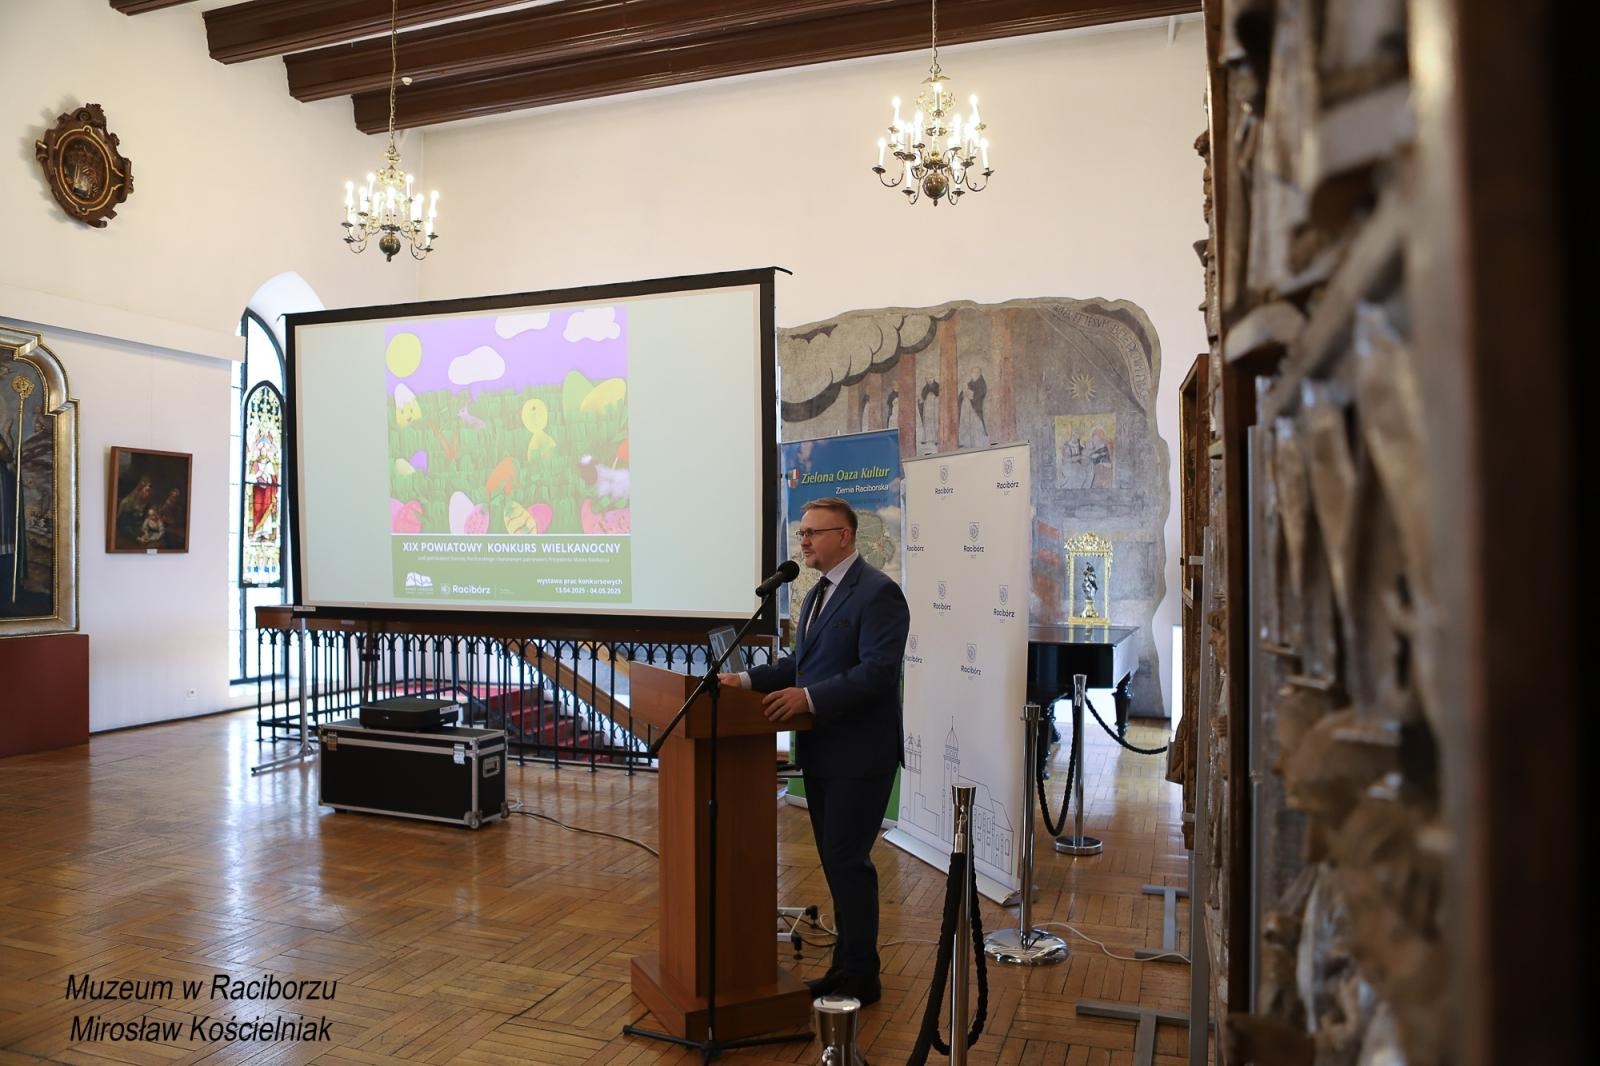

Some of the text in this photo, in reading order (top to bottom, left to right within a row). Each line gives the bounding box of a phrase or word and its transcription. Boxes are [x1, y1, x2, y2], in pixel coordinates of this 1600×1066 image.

[801, 465, 890, 485] Zielona Oaza Kultur
[855, 483, 889, 493] Raciborska
[996, 480, 1019, 489] Racibórz
[935, 487, 953, 496] Racibórz
[402, 542, 621, 553] XIX POWIATOWY KONKURS WIELKANOCNY
[963, 545, 985, 553] Racibórz
[578, 578, 623, 586] konkursowych
[452, 584, 490, 594] Racibórz
[933, 602, 951, 612] Racibórz
[993, 608, 1015, 619] Racibórz
[960, 664, 982, 676] Racibórz
